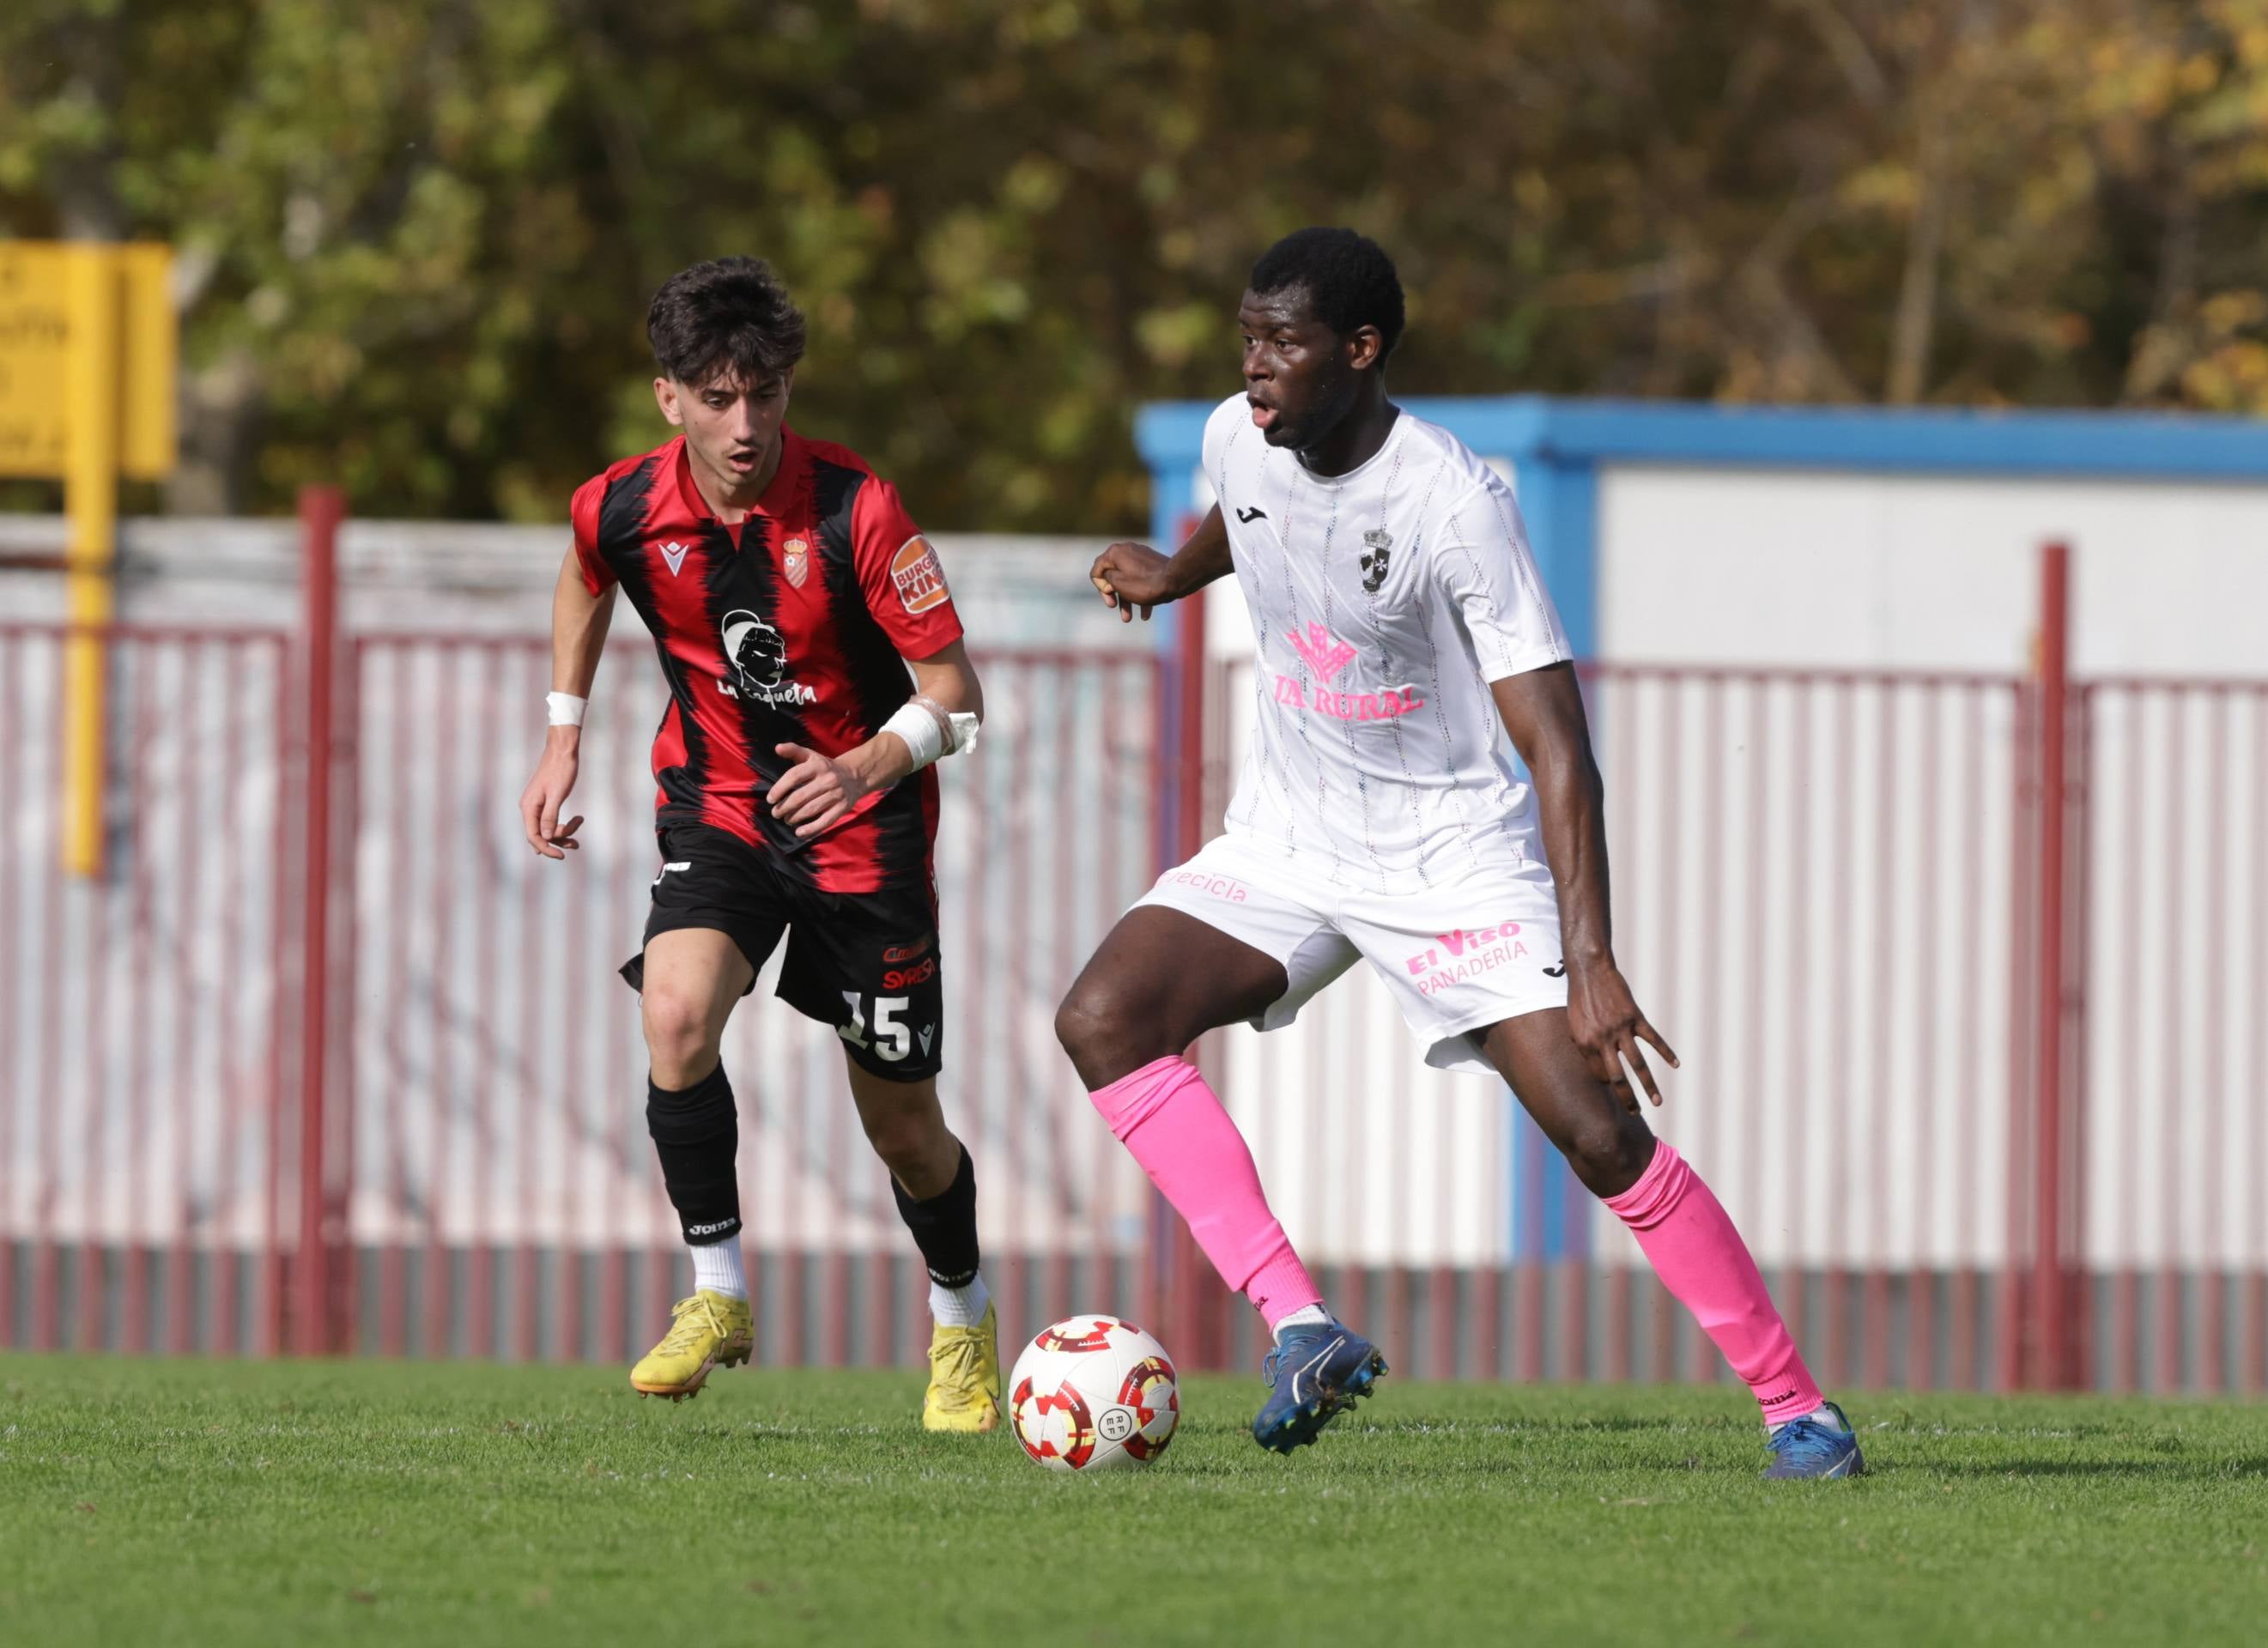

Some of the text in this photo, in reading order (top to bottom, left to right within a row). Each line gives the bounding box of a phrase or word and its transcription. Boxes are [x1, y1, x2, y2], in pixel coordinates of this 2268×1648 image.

[1314, 687, 1427, 722] RURAL
[1417, 941, 1529, 997] PANADERÍA
[838, 991, 911, 1062] 15
